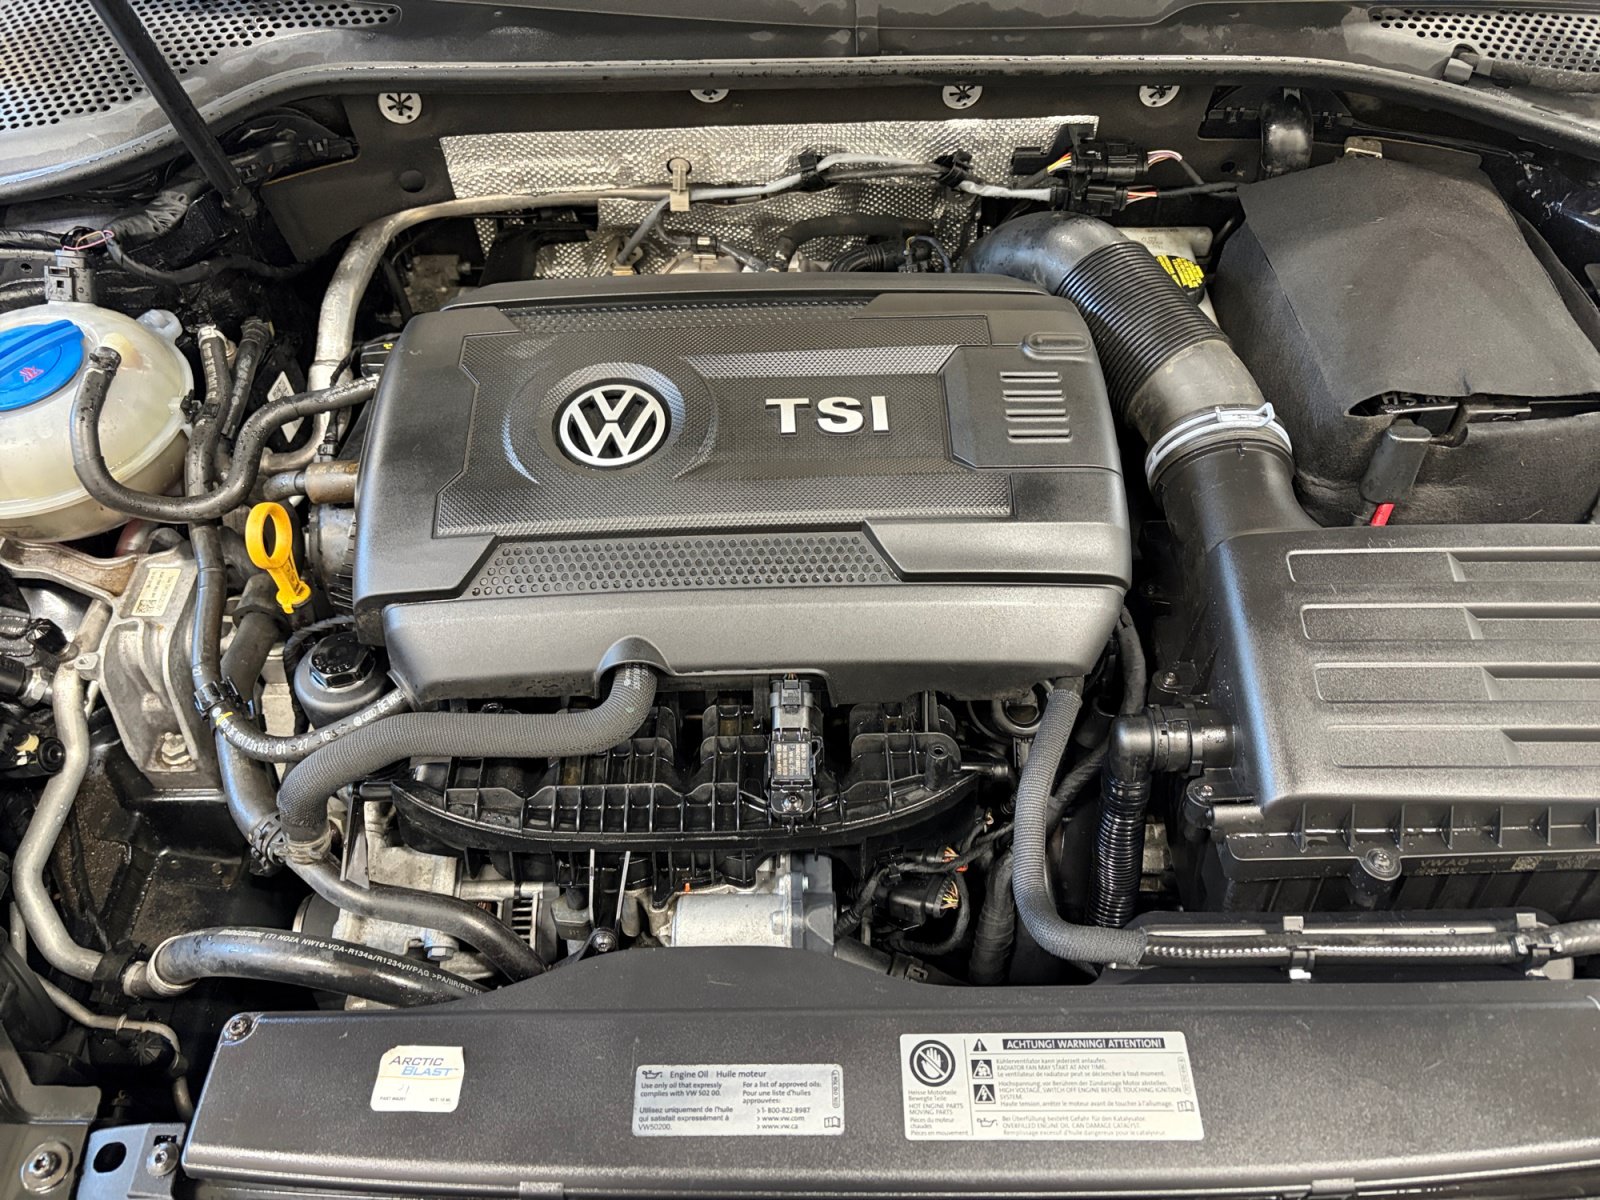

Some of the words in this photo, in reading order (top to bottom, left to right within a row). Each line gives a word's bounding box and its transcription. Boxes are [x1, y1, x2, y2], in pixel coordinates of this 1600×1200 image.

[766, 395, 889, 435] TSI
[1006, 1039, 1055, 1049] ACHTUNG!
[1057, 1039, 1106, 1049] WARNING!
[1108, 1039, 1161, 1048] ATTENTION!
[389, 1055, 444, 1066] ARCTIC
[401, 1066, 453, 1076] BLAST
[670, 1071, 696, 1080] Engine
[698, 1070, 709, 1078] Oil
[716, 1070, 737, 1078] Huile
[654, 1082, 667, 1090] only
[693, 1082, 722, 1090] expressly
[640, 1090, 668, 1098] complies
[640, 1106, 663, 1114] Utilisez
[664, 1106, 703, 1115] uniquement
